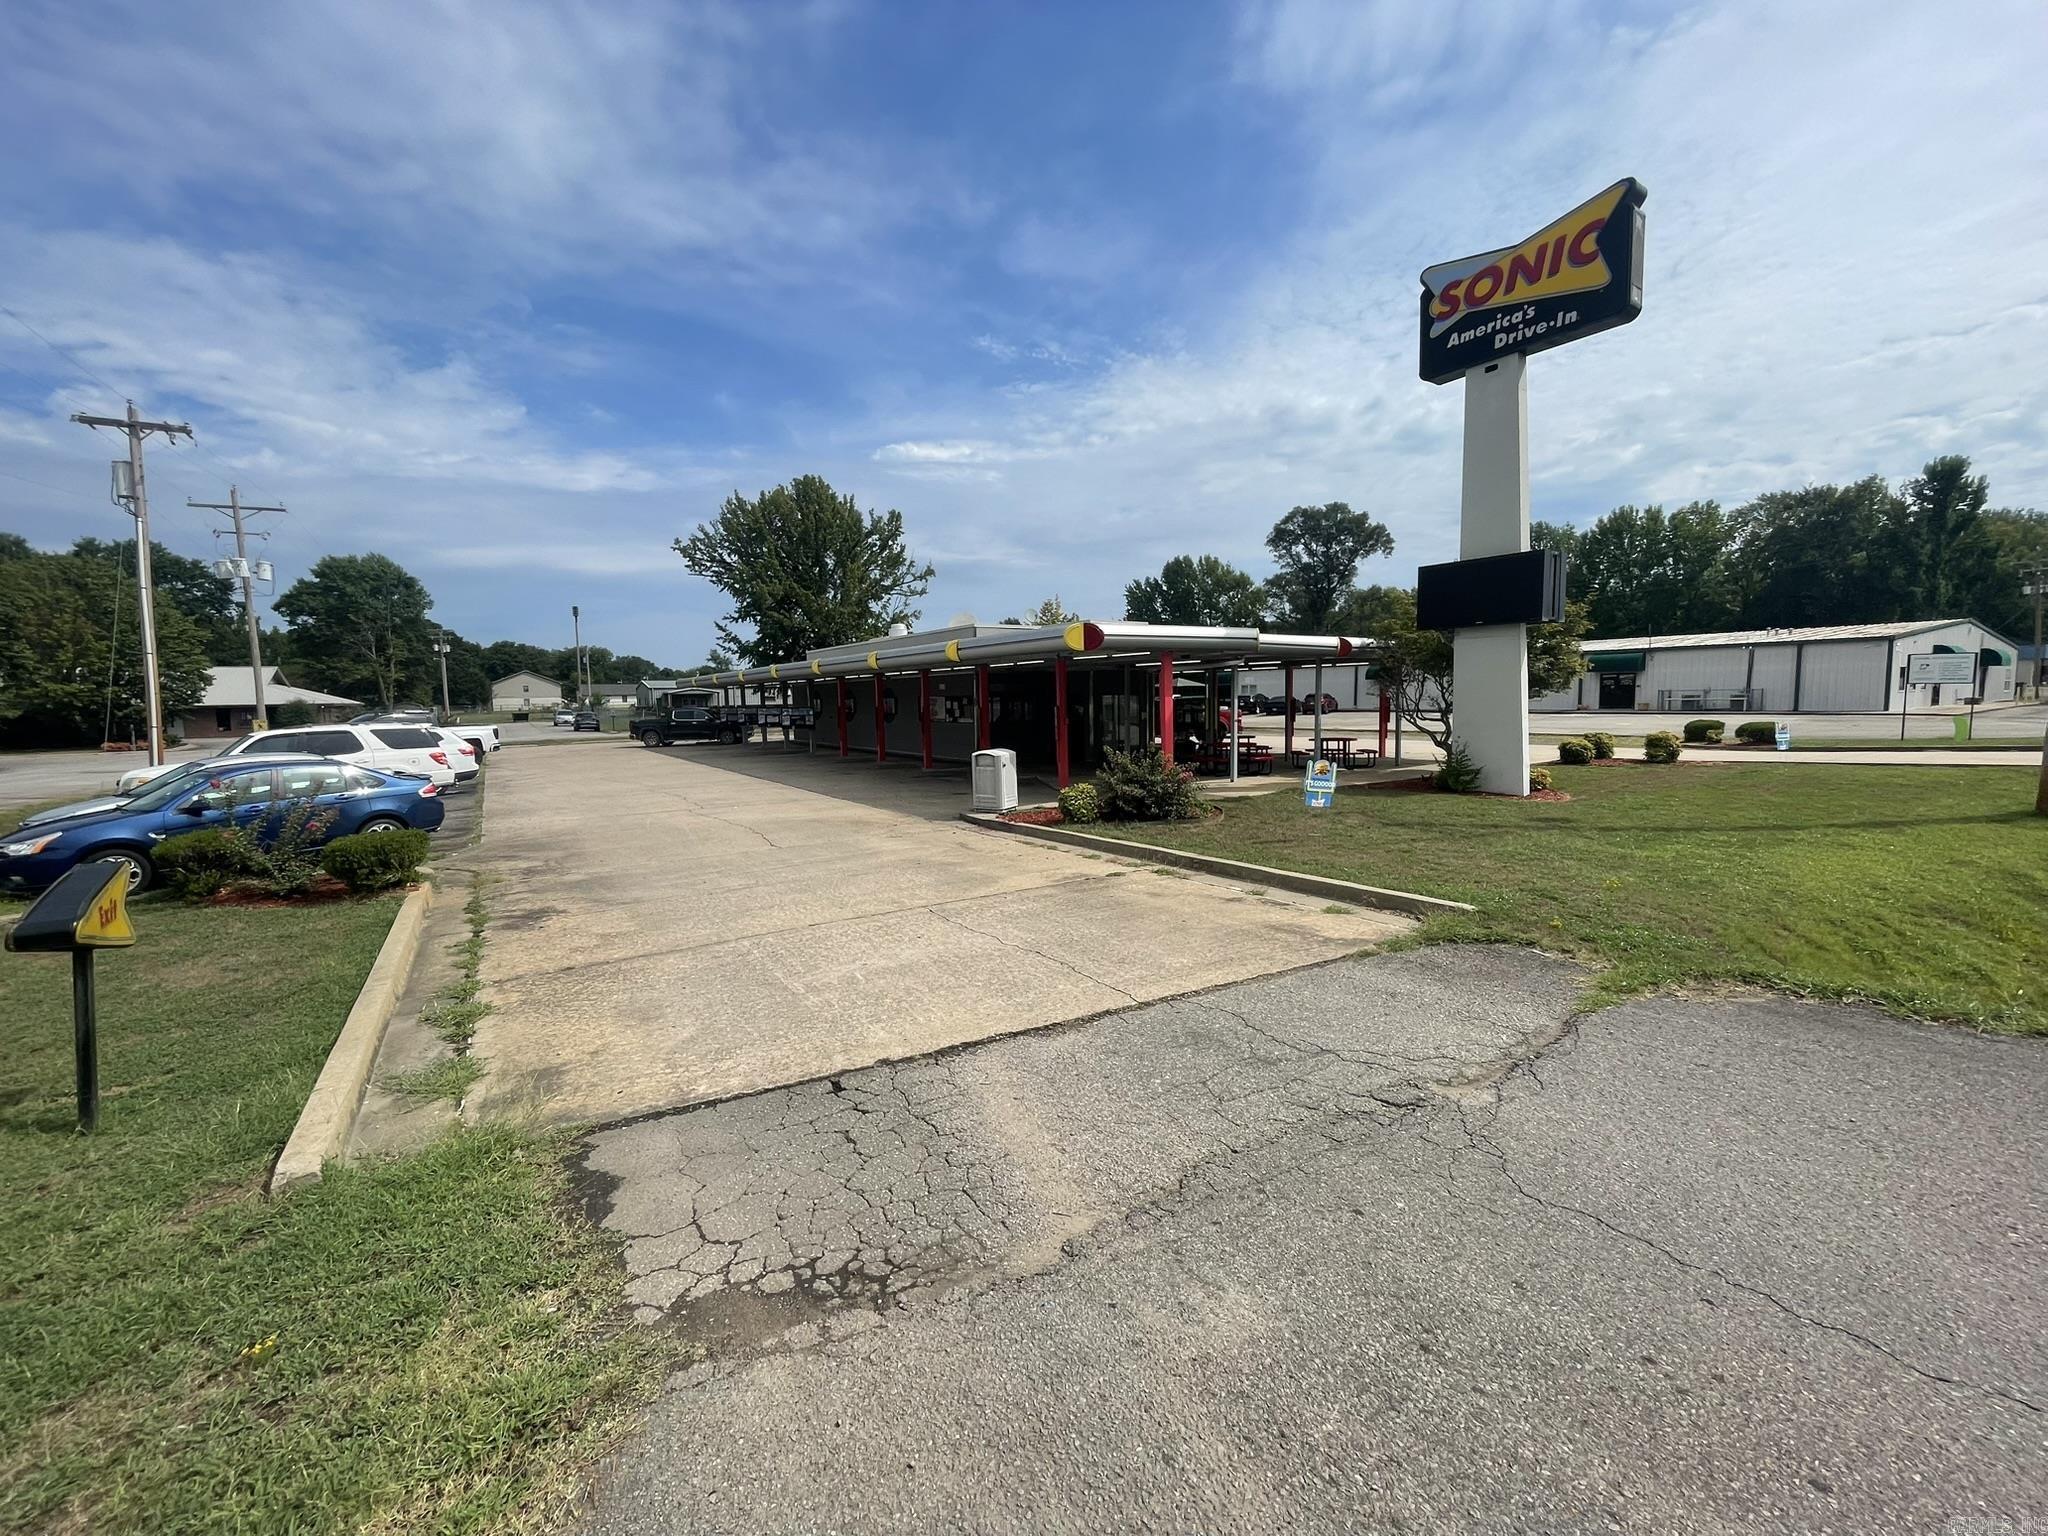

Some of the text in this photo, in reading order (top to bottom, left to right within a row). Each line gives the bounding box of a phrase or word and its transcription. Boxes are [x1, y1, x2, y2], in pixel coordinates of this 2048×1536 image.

[1435, 217, 1606, 322] SONIC
[1446, 304, 1536, 349] America's
[98, 897, 117, 929] Exit
